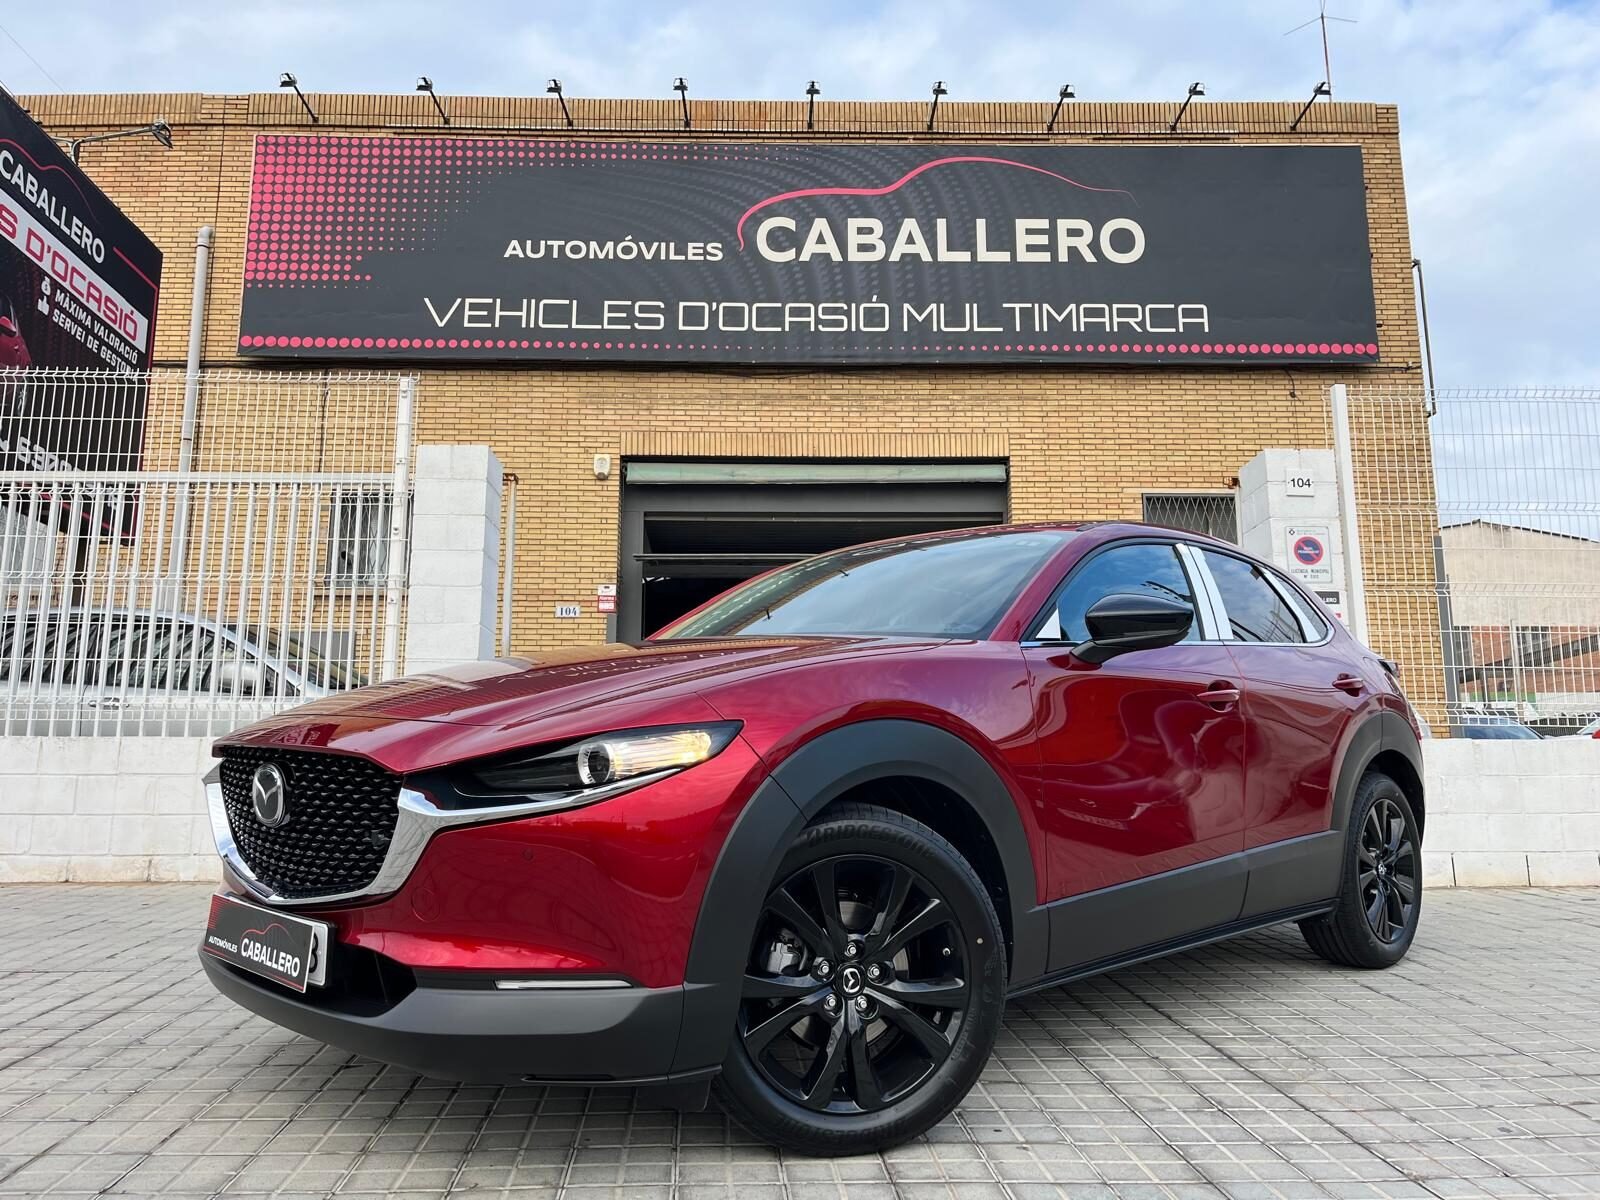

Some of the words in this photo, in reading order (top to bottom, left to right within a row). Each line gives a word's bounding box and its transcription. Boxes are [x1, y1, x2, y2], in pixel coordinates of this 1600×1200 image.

[0, 150, 104, 264] CABALLERO
[504, 235, 724, 261] AUTOMÓVILES
[756, 216, 1145, 264] CABALLERO
[25, 227, 138, 342] D'OCASIÓ
[52, 309, 86, 343] SERVEI
[87, 335, 100, 354] DE
[423, 297, 665, 331] VEHICLES
[678, 295, 889, 332] D'OCASIÓ
[903, 302, 1209, 333] MULTIMARCA
[94, 320, 138, 364] VALORACIÓ
[1290, 478, 1312, 488] 104
[560, 607, 577, 616] 104
[208, 935, 238, 953] AUTOMÓVILES
[241, 938, 300, 977] CABALLERO
